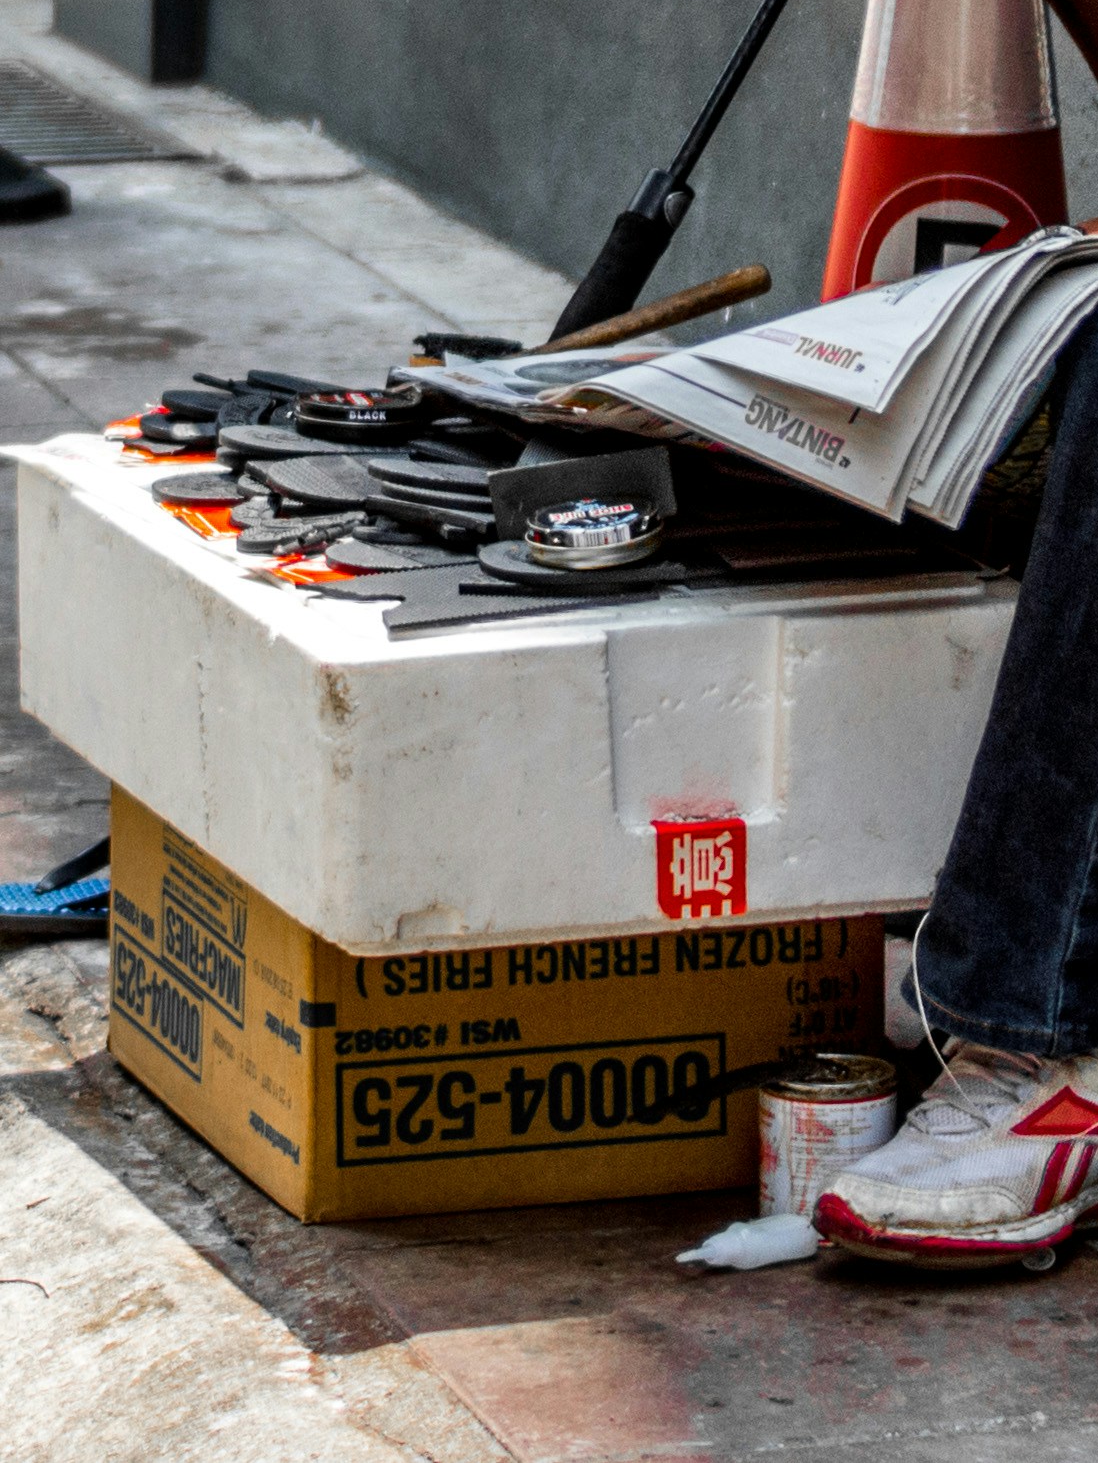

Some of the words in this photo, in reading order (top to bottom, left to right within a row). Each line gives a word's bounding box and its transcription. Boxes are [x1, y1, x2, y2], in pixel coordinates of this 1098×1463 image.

[794, 336, 863, 369] JURNAL
[349, 410, 387, 421] BLACK
[745, 399, 845, 462] BINTANG
[669, 831, 734, 918] 意
[166, 906, 241, 1012] MACFRIES
[508, 937, 660, 985] FRENCH
[675, 923, 823, 972] FROZEN
[383, 950, 493, 996] FRIES
[117, 940, 201, 1064] 00004-525
[335, 1023, 448, 1056] #30982
[460, 1018, 522, 1045] WSI
[352, 1051, 711, 1147] 00004-525
